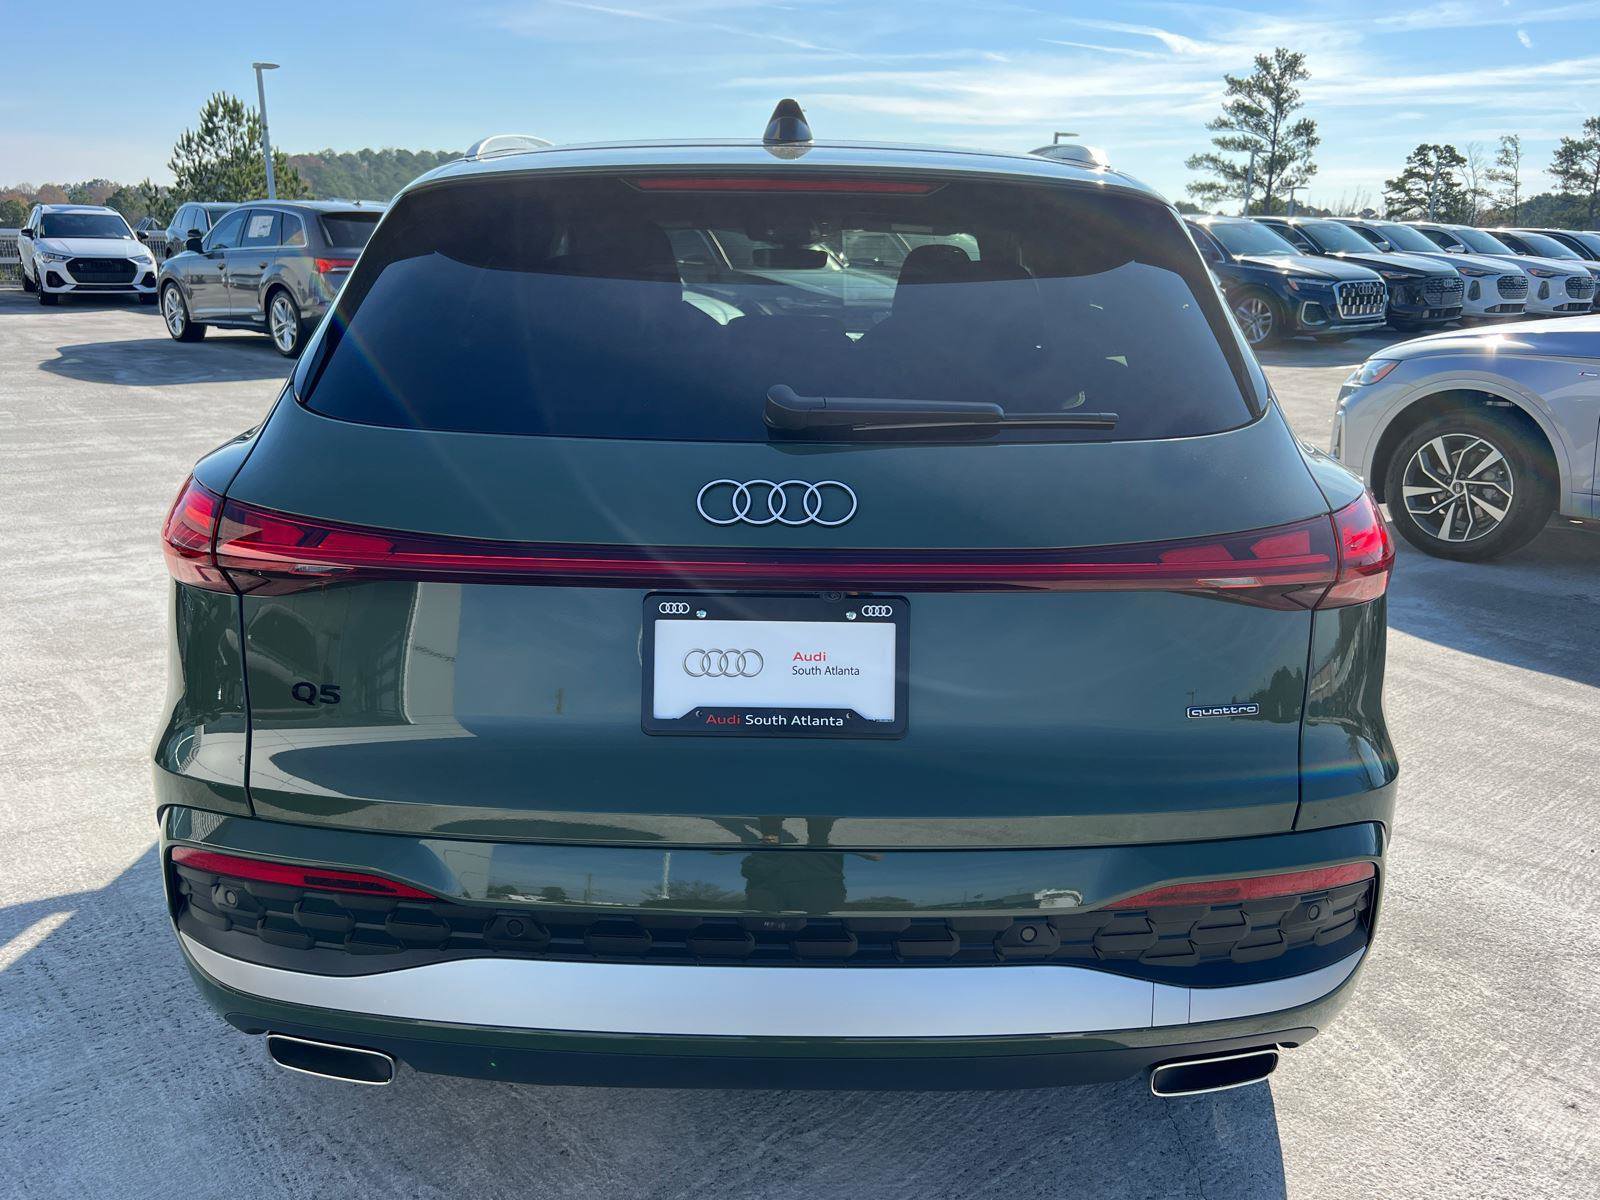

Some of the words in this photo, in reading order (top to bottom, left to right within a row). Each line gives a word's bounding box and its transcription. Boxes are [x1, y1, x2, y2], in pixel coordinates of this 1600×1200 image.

[792, 651, 827, 662] Audi
[792, 665, 822, 676] South
[824, 665, 860, 676] Atlanta
[291, 681, 341, 706] Q5
[1191, 705, 1256, 717] quattro
[705, 713, 741, 725] Audi
[745, 714, 787, 726] South
[790, 715, 844, 727] Atlanta
